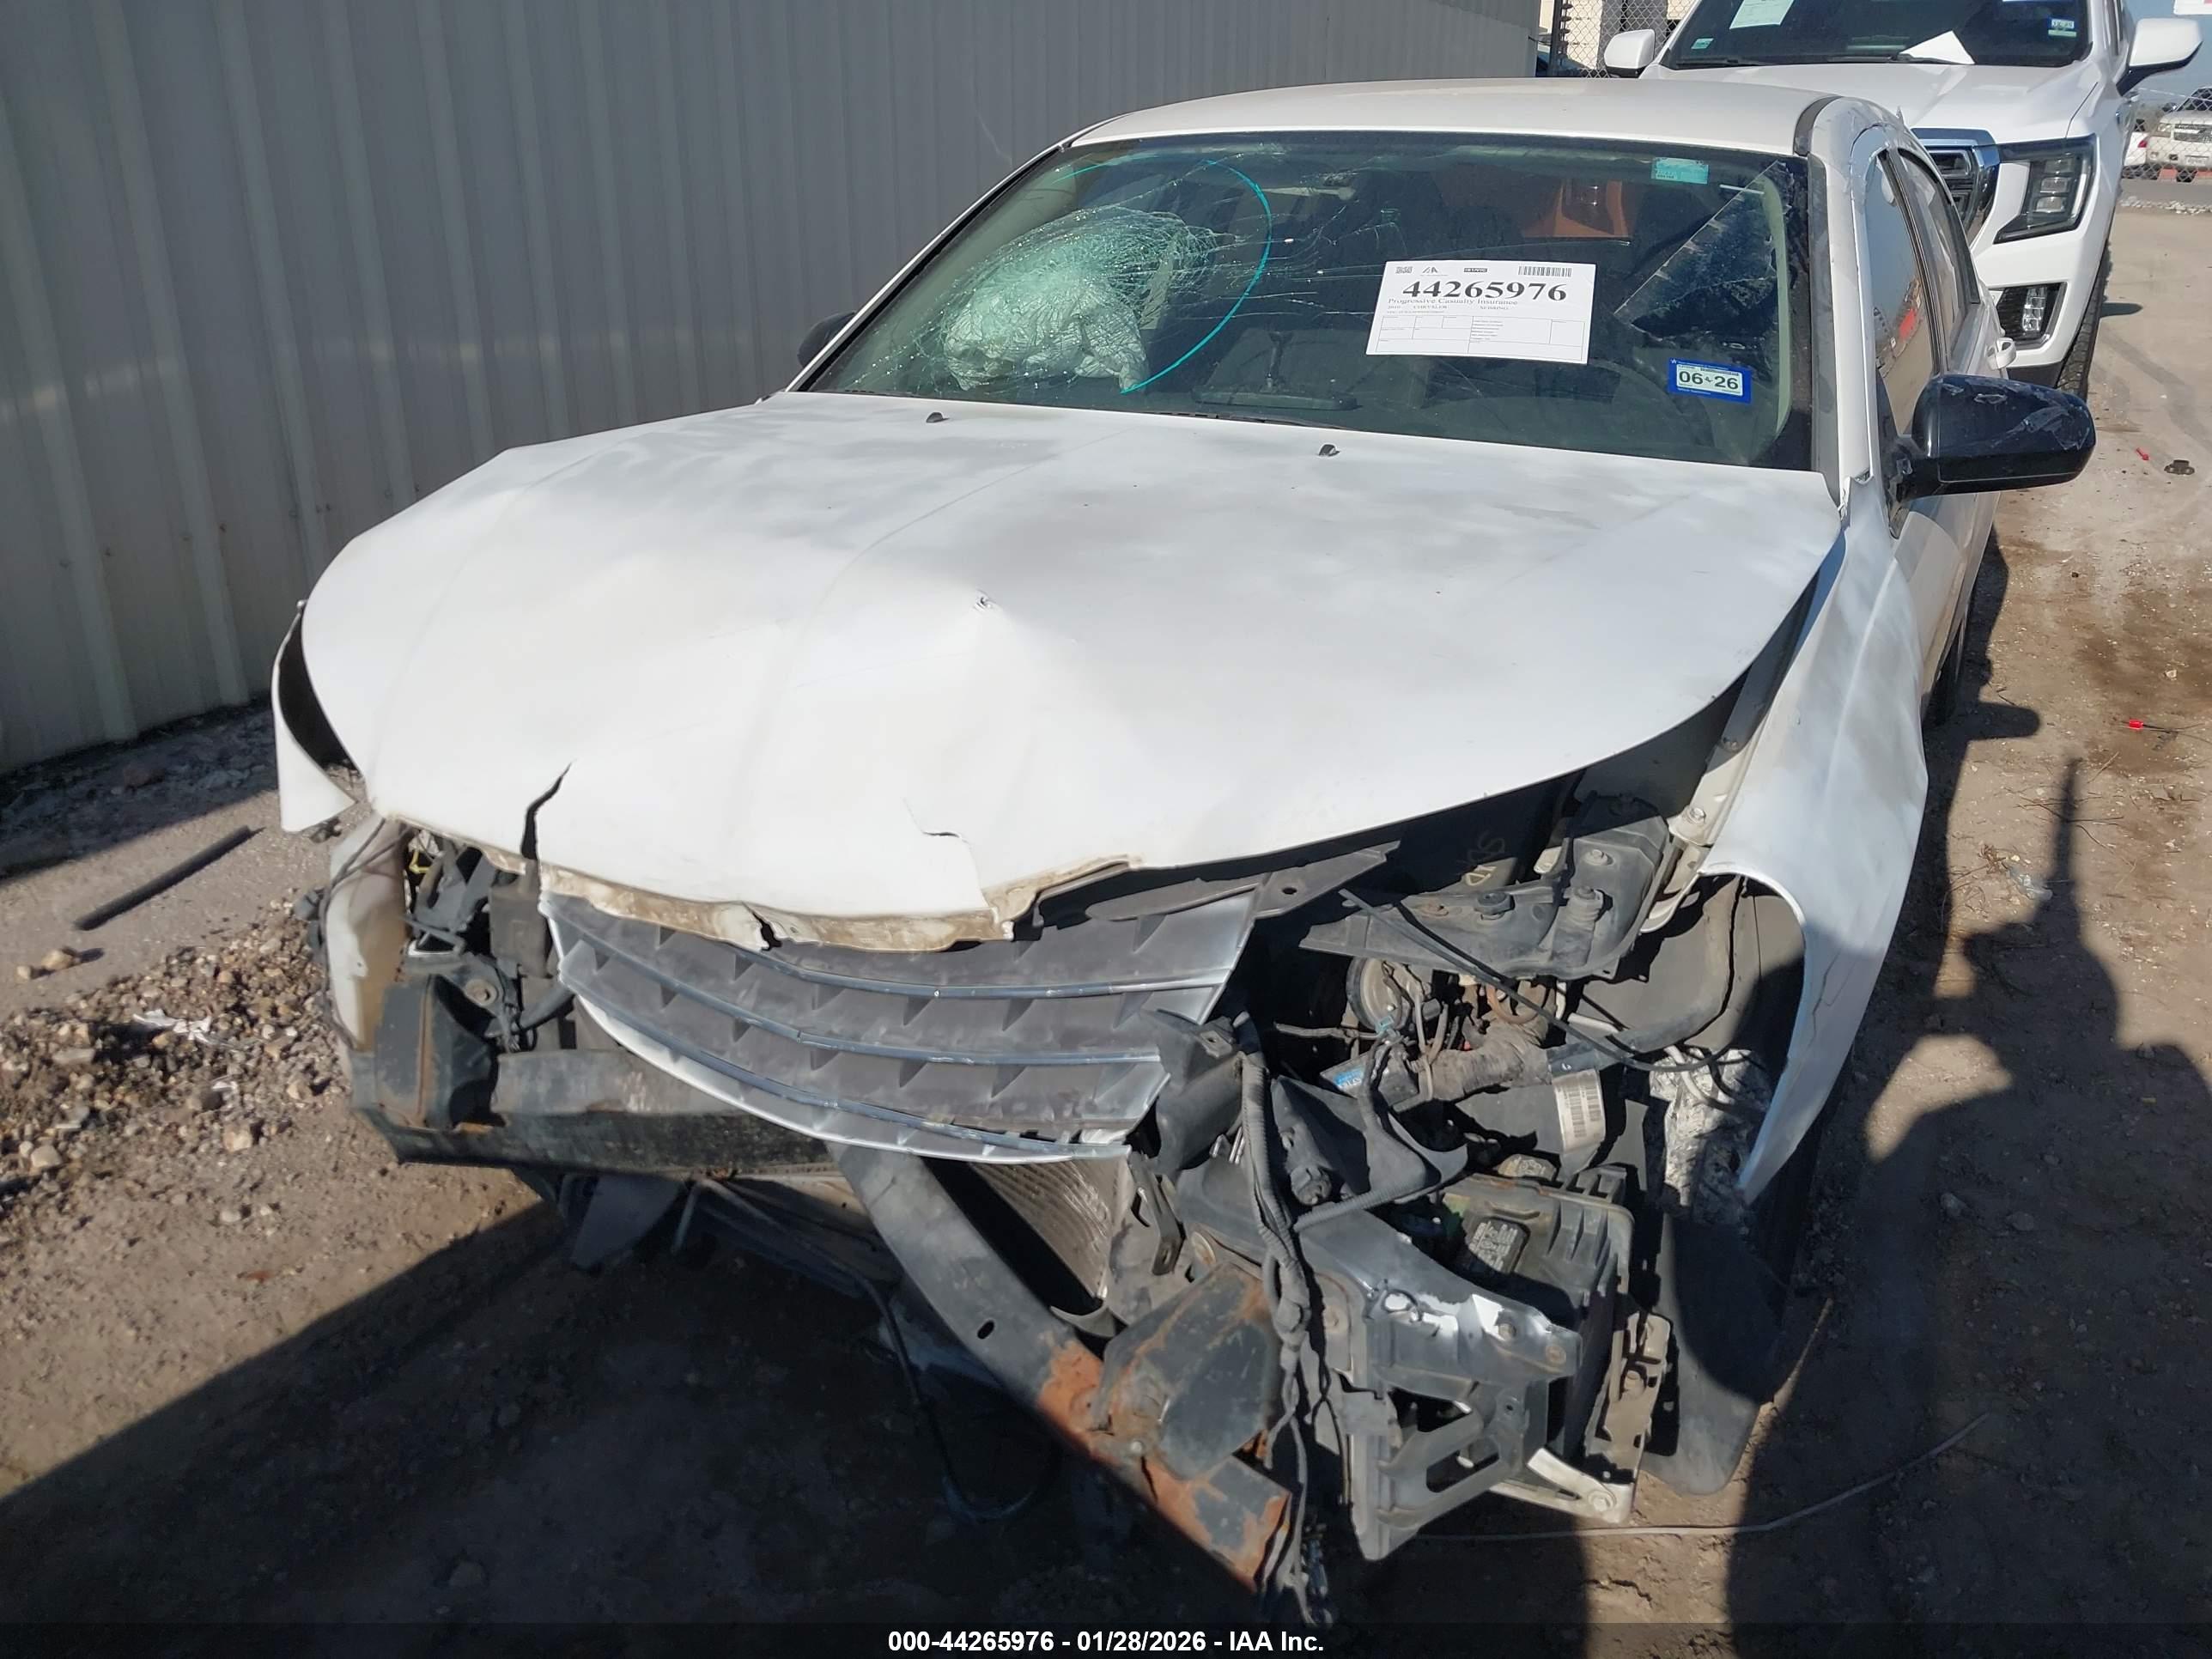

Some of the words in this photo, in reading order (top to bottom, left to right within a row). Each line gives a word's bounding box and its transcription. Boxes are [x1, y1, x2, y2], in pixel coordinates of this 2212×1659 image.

[1402, 280, 1567, 301] 44265976
[1388, 297, 1437, 306] Progressive
[1679, 370, 1704, 386] 06
[1713, 375, 1739, 390] 26
